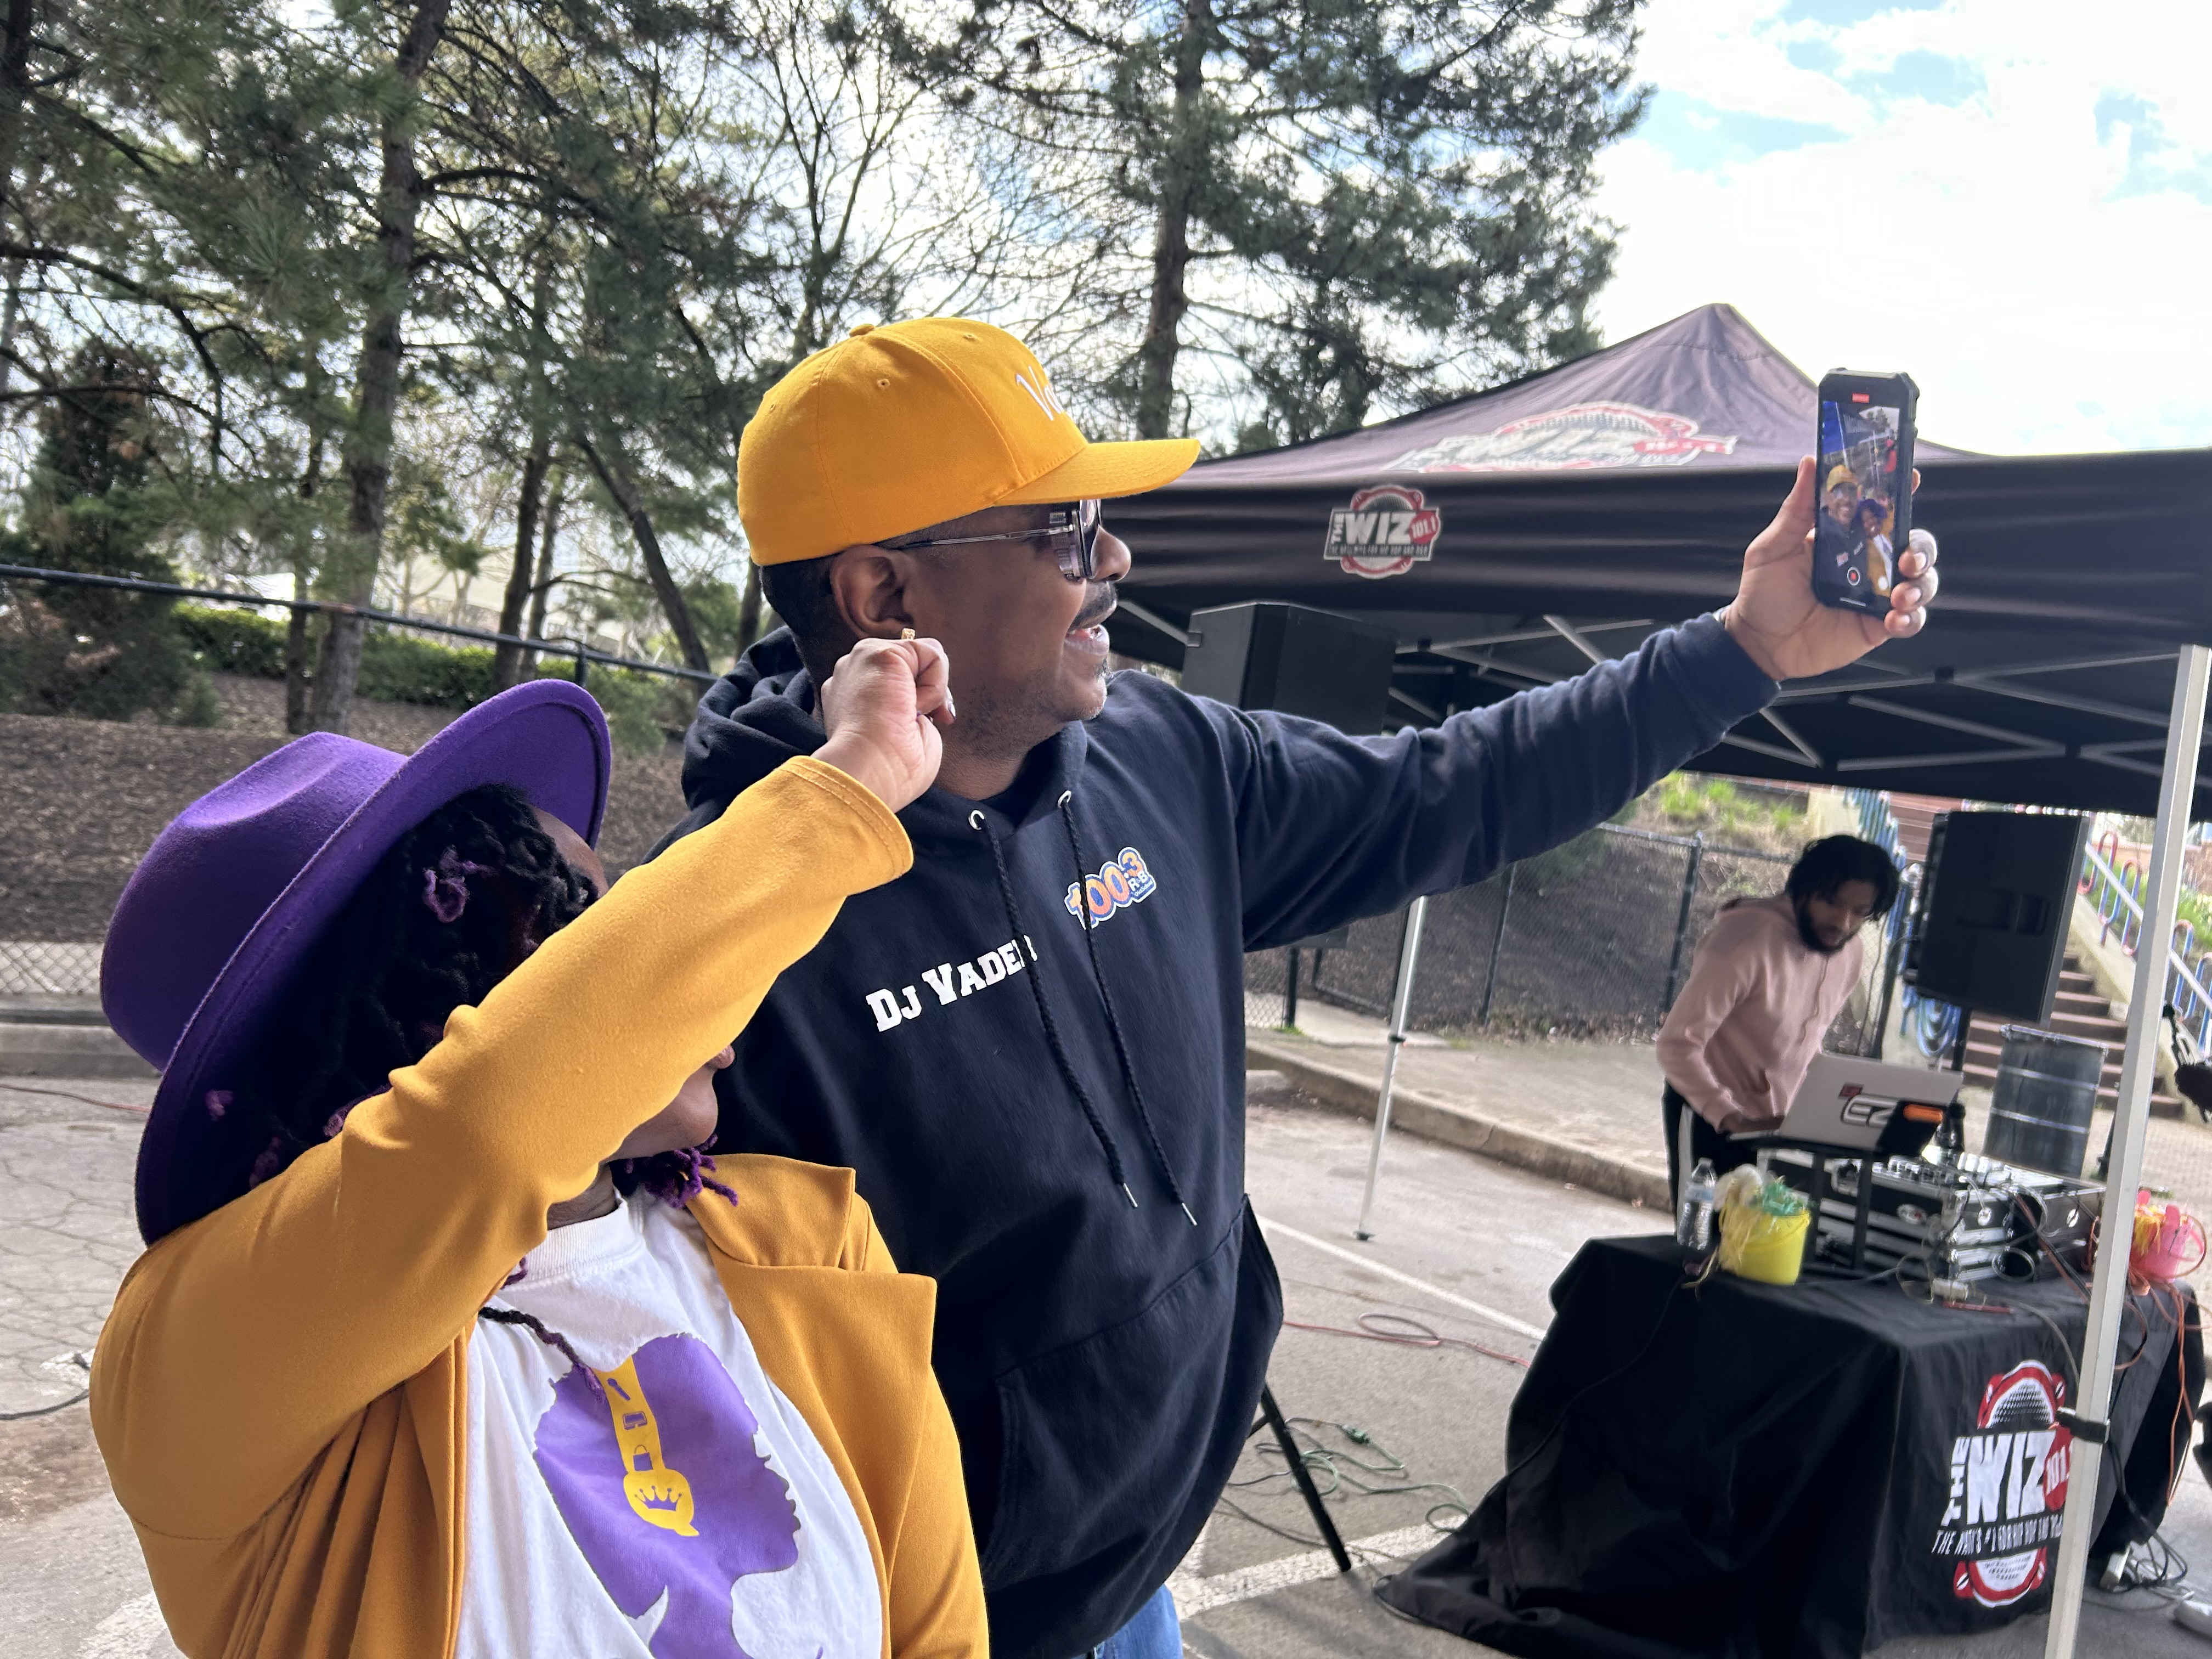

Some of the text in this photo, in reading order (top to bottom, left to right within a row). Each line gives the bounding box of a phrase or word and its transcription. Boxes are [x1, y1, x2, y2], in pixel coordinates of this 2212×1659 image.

[1345, 512, 1417, 545] WIZ
[1941, 1436, 1971, 1527] THE
[1966, 1430, 2057, 1525] WIZ
[1931, 1529, 1957, 1555] THE
